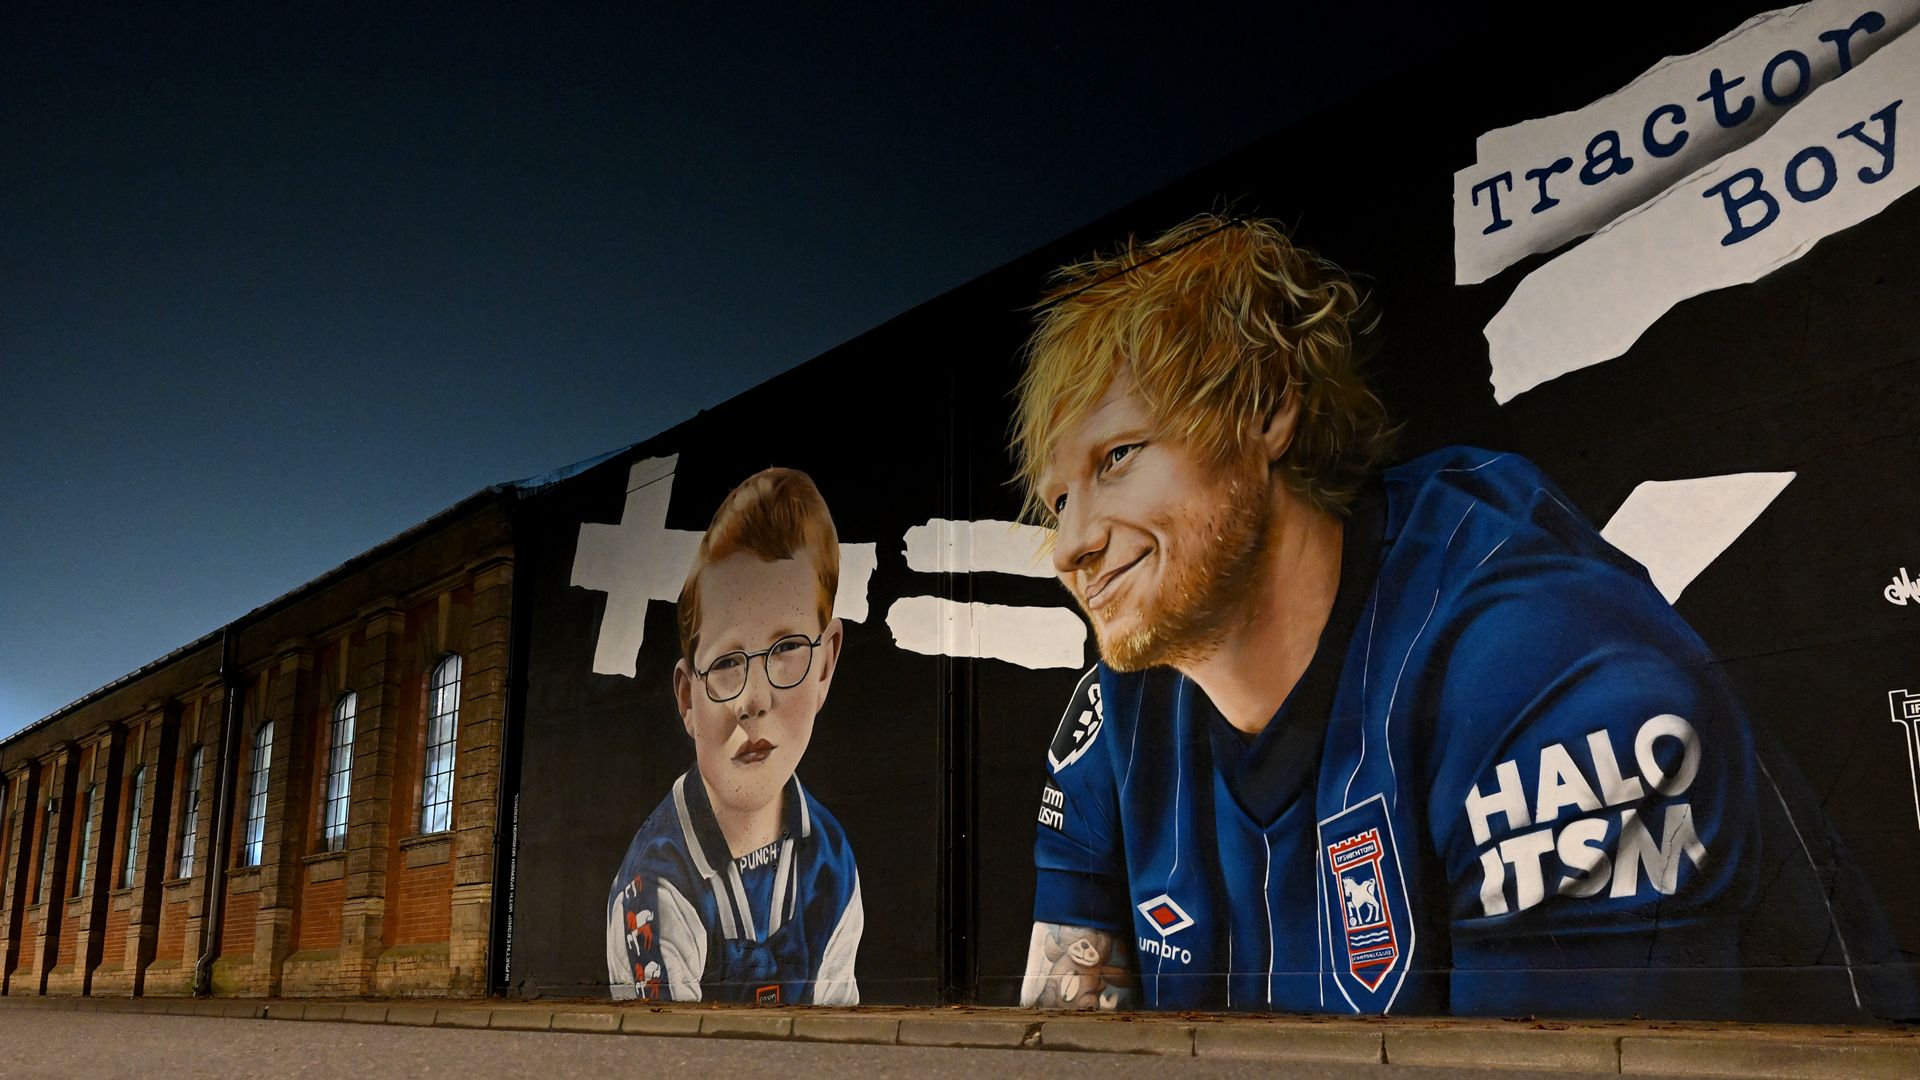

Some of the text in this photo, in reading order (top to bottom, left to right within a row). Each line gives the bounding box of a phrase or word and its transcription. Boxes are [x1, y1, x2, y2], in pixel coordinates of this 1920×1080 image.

[1471, 11, 1886, 235] Tractor
[1702, 99, 1903, 247] Boy
[1465, 714, 1701, 847] HALO
[740, 846, 777, 875] PUNCH
[1480, 804, 1707, 917] ITSM
[1138, 936, 1192, 964] umbro
